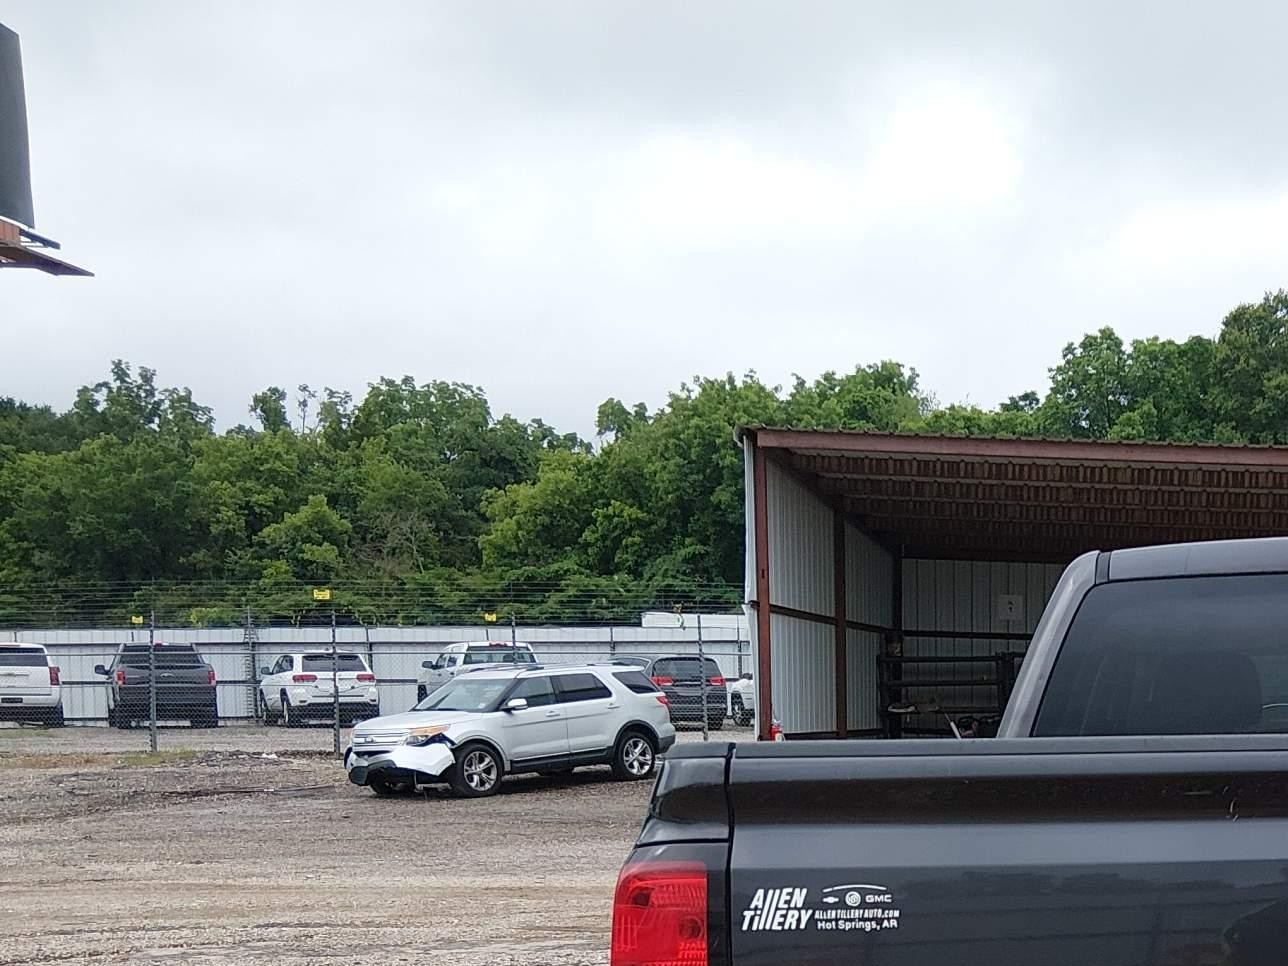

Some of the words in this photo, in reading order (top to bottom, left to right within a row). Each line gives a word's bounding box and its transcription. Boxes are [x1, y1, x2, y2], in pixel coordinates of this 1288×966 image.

[865, 895, 892, 903] GMC
[817, 920, 836, 930] Hot
[838, 918, 881, 932] Springs,
[882, 918, 898, 928] AR
